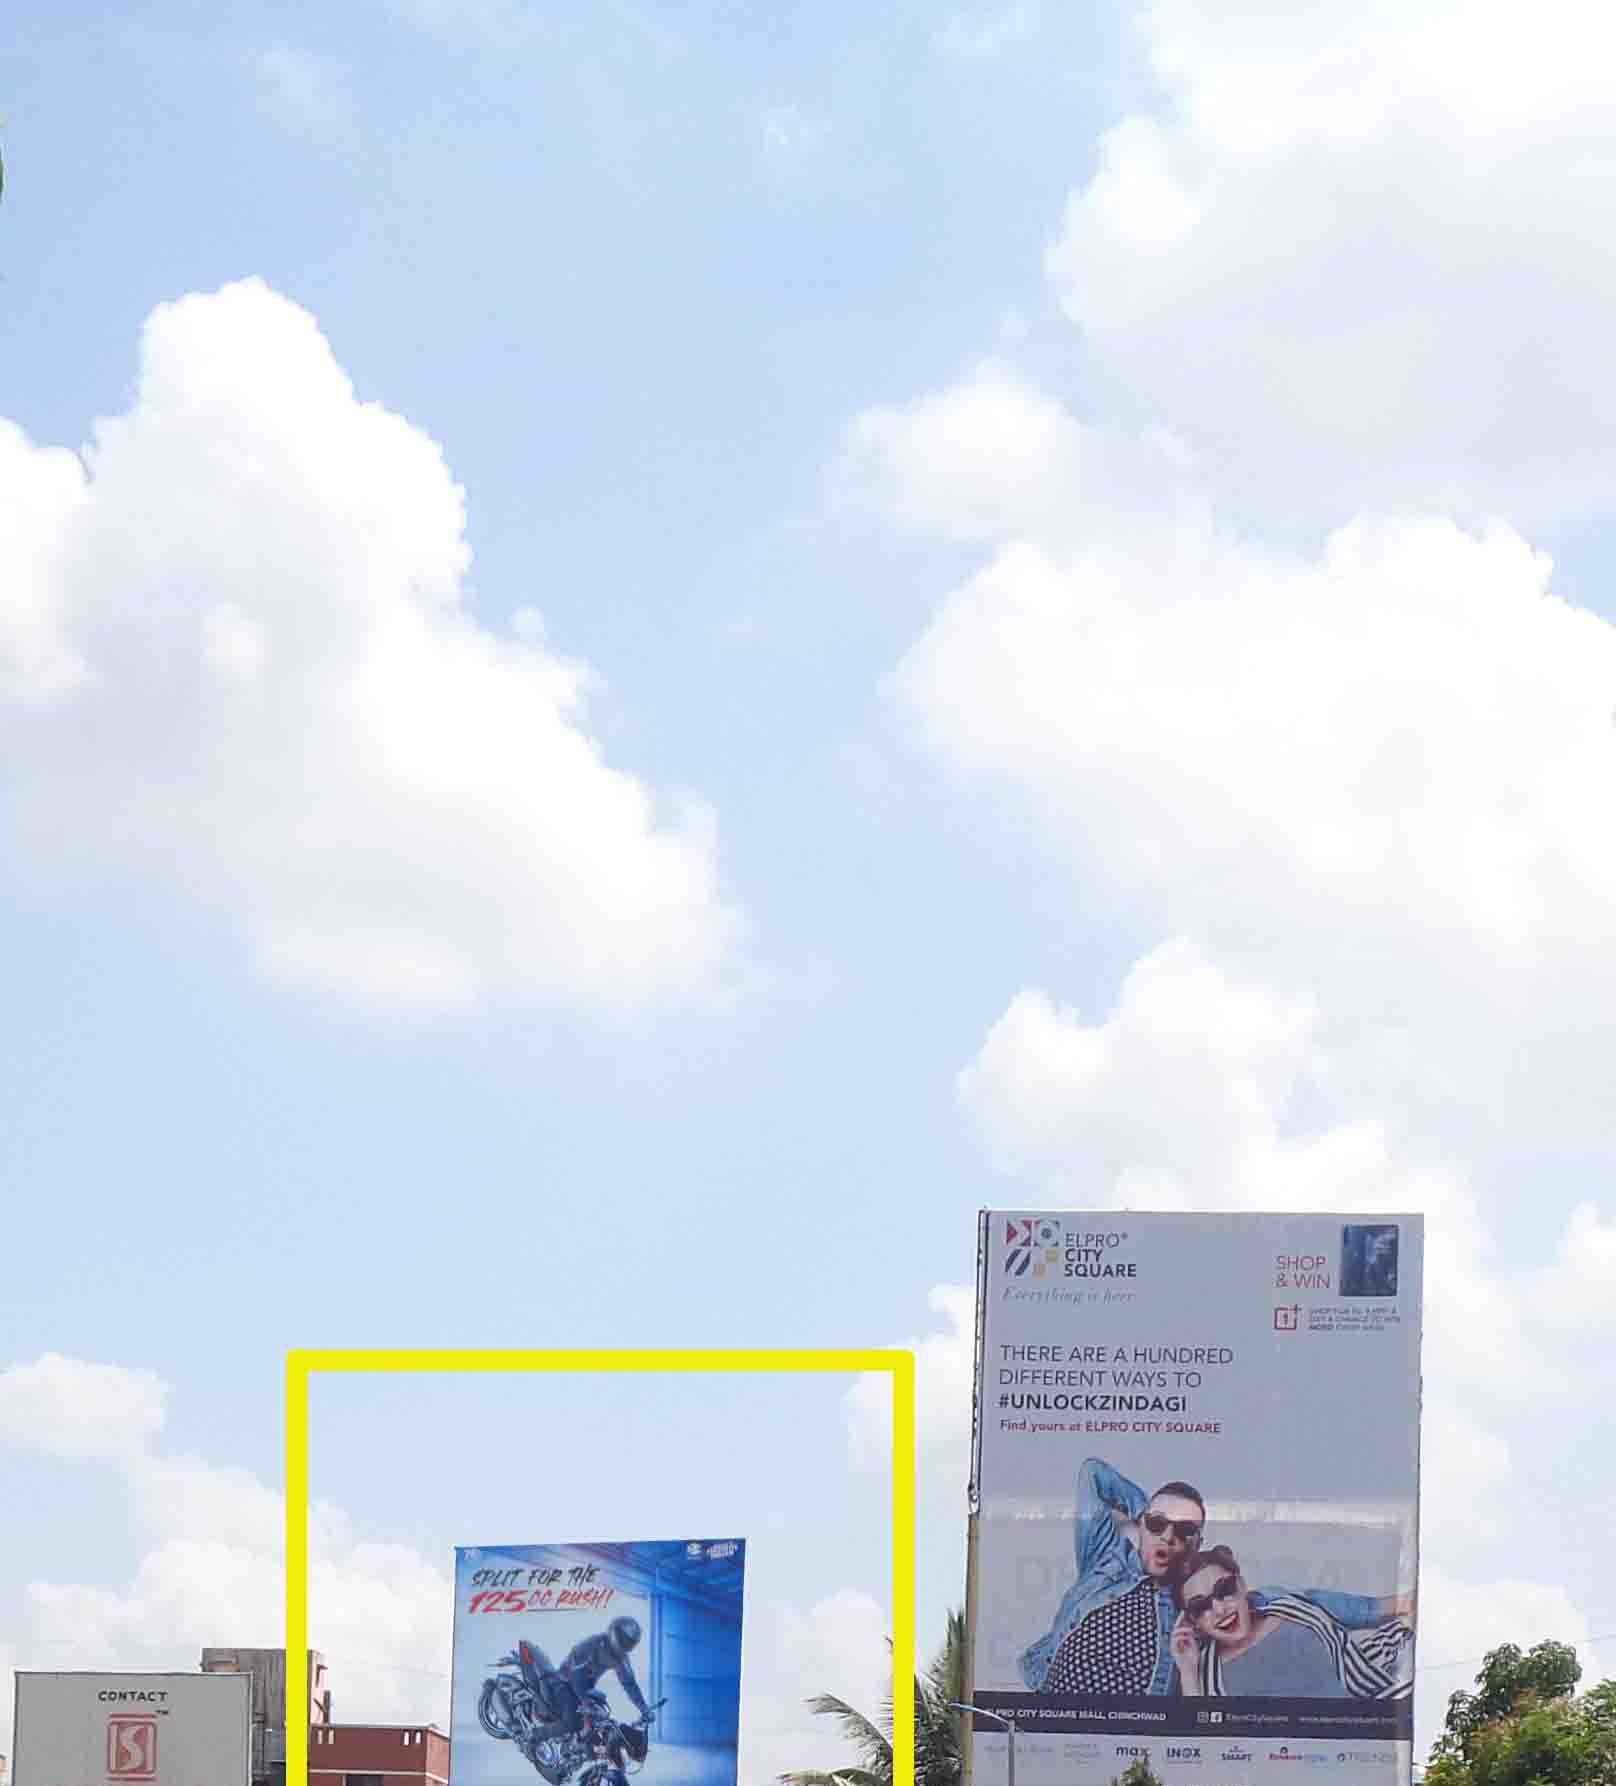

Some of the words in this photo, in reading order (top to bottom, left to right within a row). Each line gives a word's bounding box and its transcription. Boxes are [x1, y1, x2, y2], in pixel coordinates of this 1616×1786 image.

[1065, 1232, 1120, 1248] ELPRO
[1064, 1249, 1103, 1262] CITY
[1276, 1255, 1327, 1271] SHOP
[1064, 1263, 1137, 1278] SQUARE
[1277, 1272, 1289, 1288] &
[1294, 1273, 1331, 1289] WIN
[1000, 1344, 1064, 1362] THERE
[1068, 1346, 1107, 1362] ARE
[1113, 1347, 1128, 1363] A
[1134, 1347, 1234, 1364] HUNDRED
[999, 1369, 1107, 1387] DIFFERENT
[1112, 1371, 1167, 1388] WAYS
[1172, 1372, 1202, 1388] TO
[999, 1393, 1187, 1412] #UNLOCKZINDAGI
[1000, 1419, 1027, 1433] Find
[1031, 1422, 1066, 1434] yours
[1085, 1421, 1128, 1433] ELPRO
[1132, 1422, 1161, 1433] CITY
[1165, 1422, 1222, 1434] SQUARE
[471, 1568, 524, 1587] SPLIT
[528, 1568, 564, 1586] FOR
[568, 1563, 601, 1587] THE
[469, 1589, 529, 1614] 125
[97, 1690, 169, 1702] CONTACT
[1017, 1709, 1037, 1719] CITY
[1039, 1709, 1078, 1720] SQUARE
[1166, 1747, 1201, 1760] INOX
